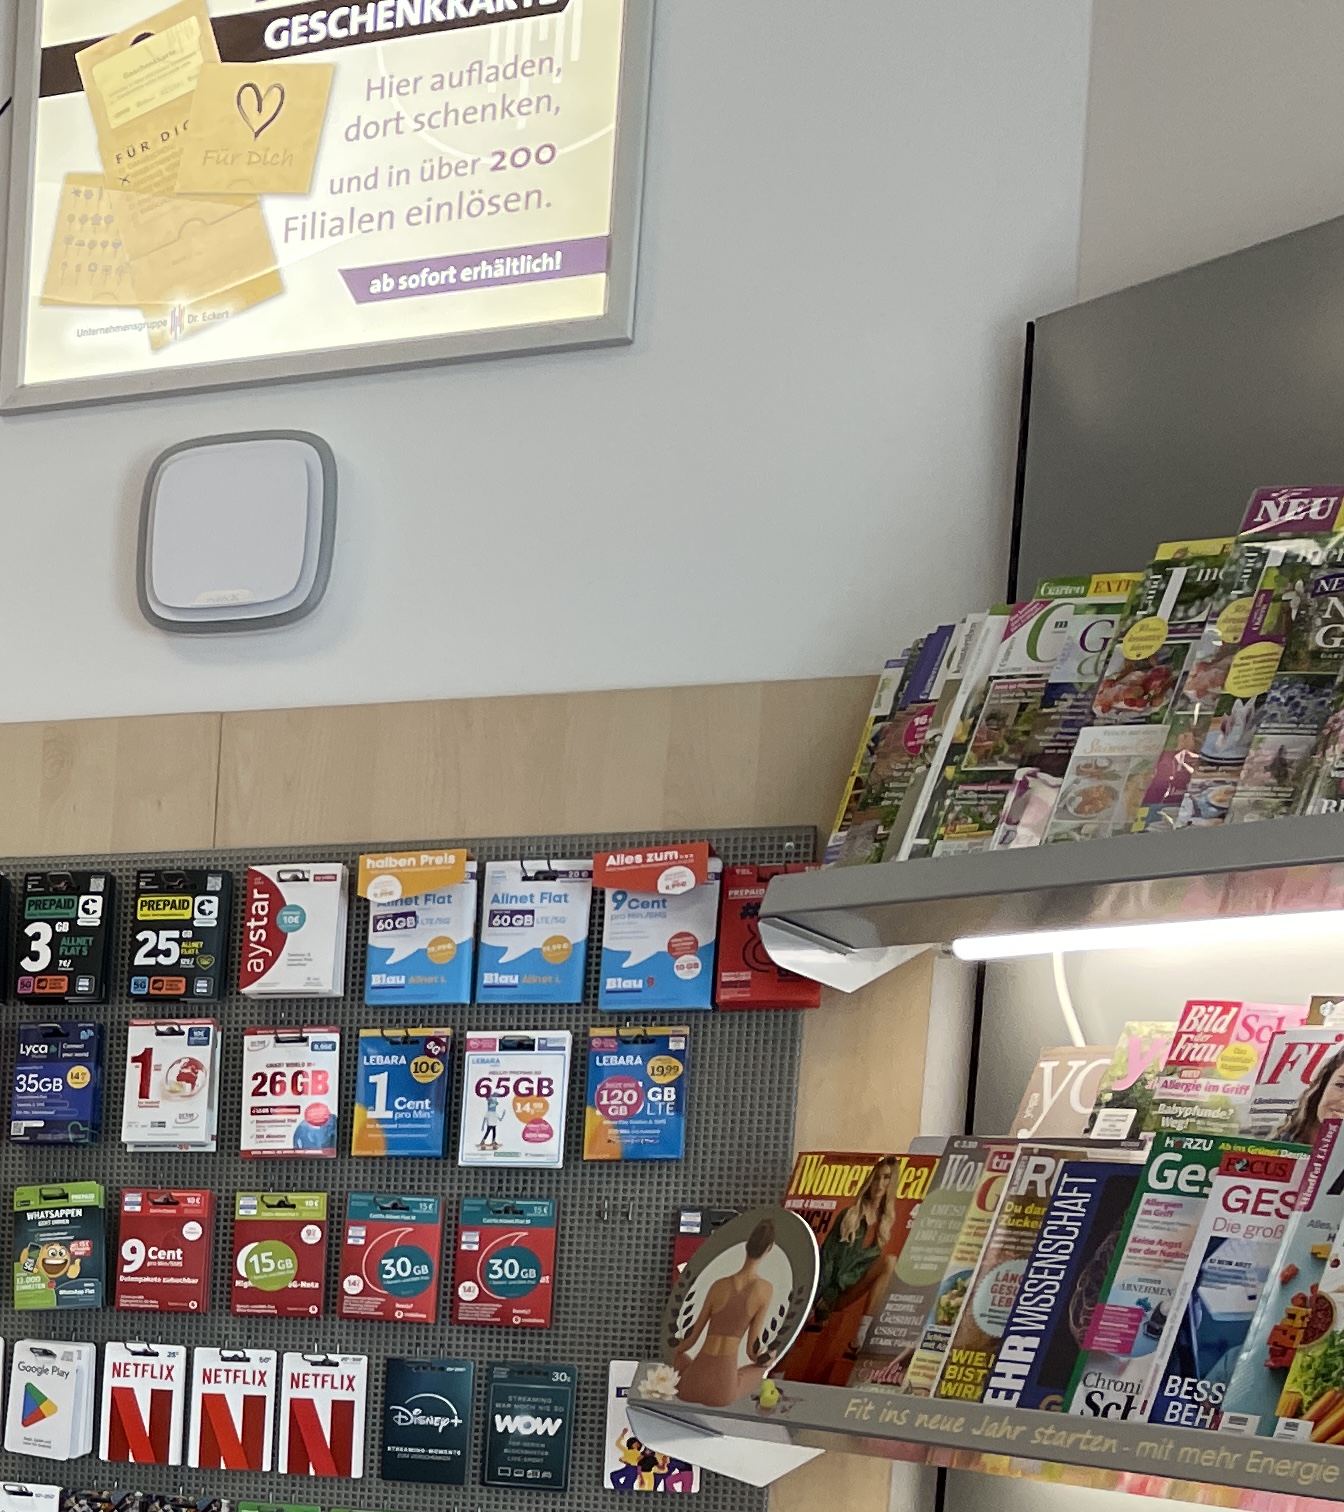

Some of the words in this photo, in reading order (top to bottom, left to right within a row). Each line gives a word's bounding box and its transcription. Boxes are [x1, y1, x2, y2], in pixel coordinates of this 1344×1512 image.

[264, 0, 560, 50] GESCHENKKA
[366, 75, 421, 101] Hier
[431, 54, 561, 92] aufladen,
[345, 113, 405, 142] dort
[412, 88, 561, 134] schenken,
[329, 168, 379, 196] und
[386, 161, 411, 189] in
[419, 152, 482, 185] über
[489, 142, 557, 173] 200
[282, 205, 396, 243] Filialen
[405, 186, 551, 227] einlösen.
[370, 271, 394, 293] ab
[398, 261, 456, 291] sofort
[461, 251, 562, 284] erhältlich!
[1253, 496, 1338, 525] NEU
[27, 899, 74, 912] PREPAID
[139, 899, 190, 912] PREPAID
[540, 891, 569, 905] Flat
[246, 888, 270, 974] aystar
[20, 921, 53, 973] 3
[134, 930, 180, 966] 25
[1180, 1005, 1238, 1033] Bild
[20, 1043, 49, 1061] Lyca
[363, 1054, 407, 1066] LEBARA
[596, 1054, 643, 1066] LEBARA
[16, 1073, 63, 1094] 35GB
[474, 1076, 554, 1099] 65GB
[599, 1089, 638, 1106] 120
[121, 1237, 146, 1273] 9
[147, 1244, 184, 1263] Cent
[1010, 1173, 1097, 1331] WISSENSCHAFT
[111, 1361, 175, 1384] NETFLIX
[201, 1366, 268, 1387] NETFLIX
[289, 1371, 356, 1392] NETFLIX
[494, 1413, 563, 1437] WOW
[844, 1398, 873, 1420] Fit
[879, 1405, 910, 1426] ins
[916, 1410, 964, 1434] neue
[971, 1416, 1022, 1440] Jahr
[1031, 1425, 1118, 1454] starten
[1136, 1431, 1174, 1459] mit
[1181, 1442, 1243, 1468] mehr
[1246, 1446, 1340, 1484] Energie
